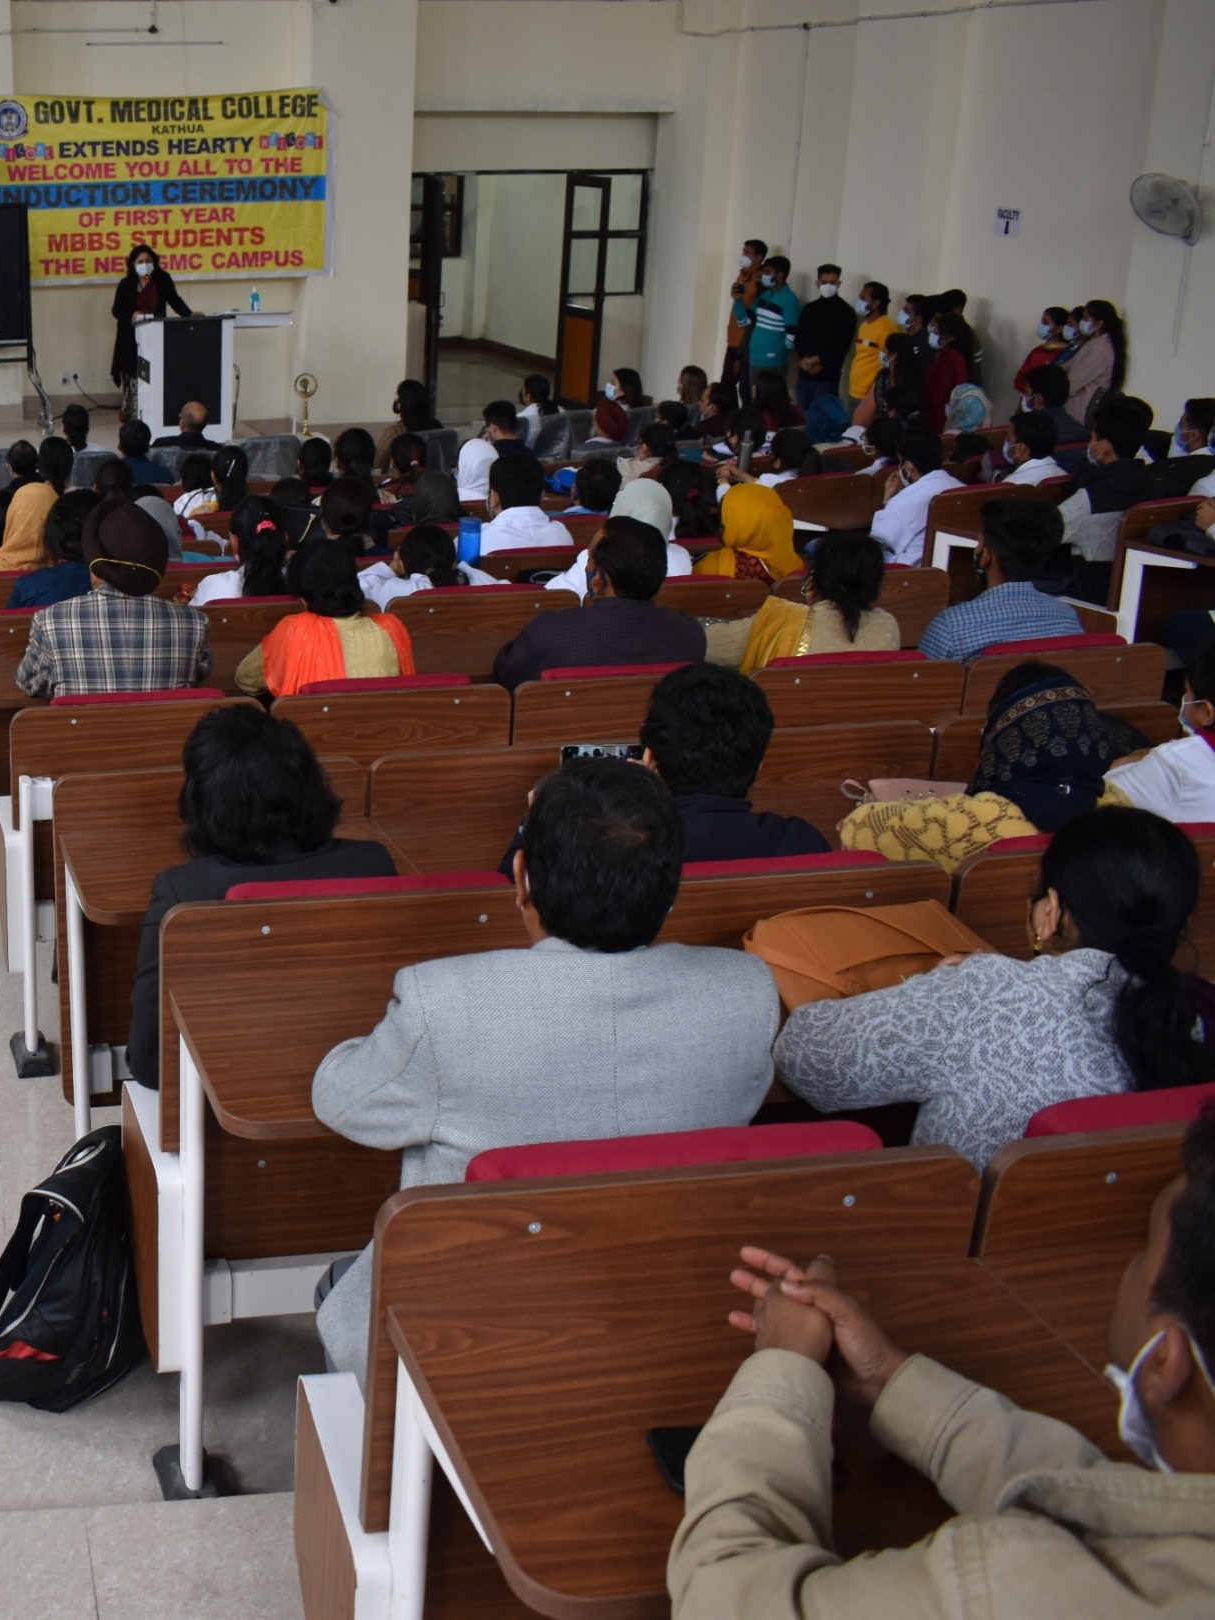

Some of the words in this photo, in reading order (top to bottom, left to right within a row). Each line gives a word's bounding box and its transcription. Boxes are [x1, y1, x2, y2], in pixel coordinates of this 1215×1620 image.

[34, 100, 103, 125] GOVT.
[110, 98, 214, 124] MEDICAL
[221, 93, 319, 120] COLLEGE
[151, 124, 205, 135] KATHUA
[58, 139, 160, 159] EXTENDS
[167, 136, 255, 156] HEARTY
[7, 162, 117, 182] WELCOME
[125, 160, 170, 178] YOU
[177, 158, 217, 177] ALL
[224, 158, 253, 176] TO
[260, 156, 303, 174] THE
[161, 178, 319, 203] CEREMONY
[78, 211, 106, 228] OF
[113, 209, 173, 226] FIRST
[180, 206, 236, 224] YEAR
[997, 208, 1020, 220] FACULTY
[47, 232, 122, 253] MBBS
[130, 226, 266, 249] STUDENTS
[40, 257, 85, 276] THE
[93, 254, 132, 274] NE
[210, 250, 305, 268] CAMPUS
